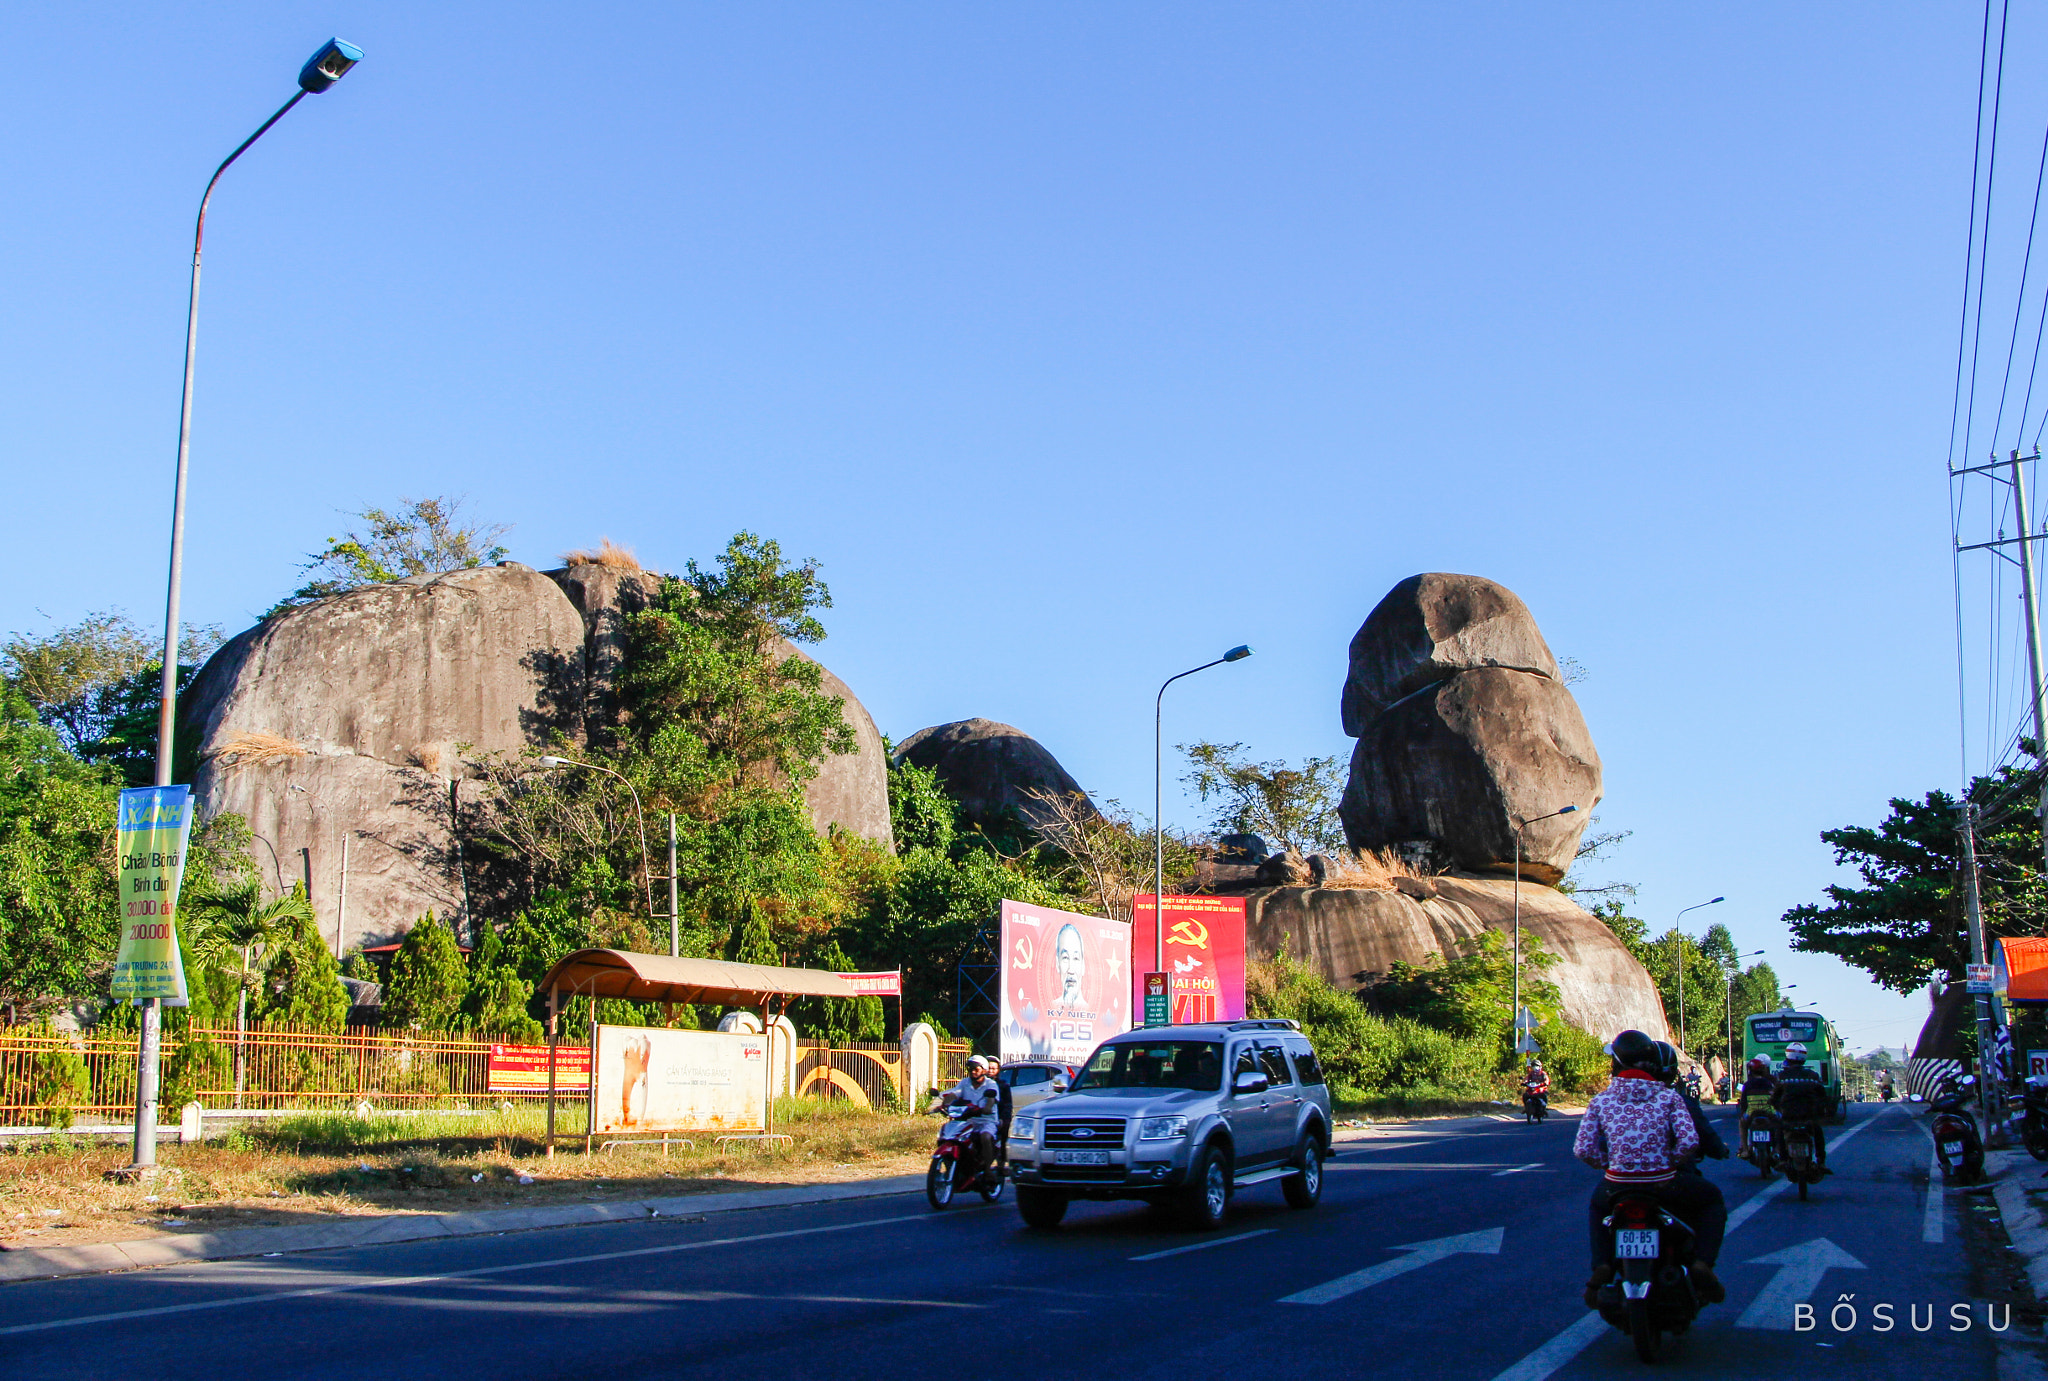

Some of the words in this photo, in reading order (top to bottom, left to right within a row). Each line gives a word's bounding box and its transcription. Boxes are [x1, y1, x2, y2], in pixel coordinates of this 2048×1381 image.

[124, 805, 184, 826] XANH
[152, 852, 166, 871] Bộ
[127, 900, 157, 917] 30.000
[130, 923, 170, 940] 200.000
[1192, 976, 1215, 993] HỘI
[1067, 1009, 1096, 1020] NIỆM
[1051, 1020, 1092, 1041] 125
[1779, 1030, 1790, 1040] 16
[1623, 1231, 1652, 1243] 60-B5
[1619, 1244, 1655, 1256] 181.41
